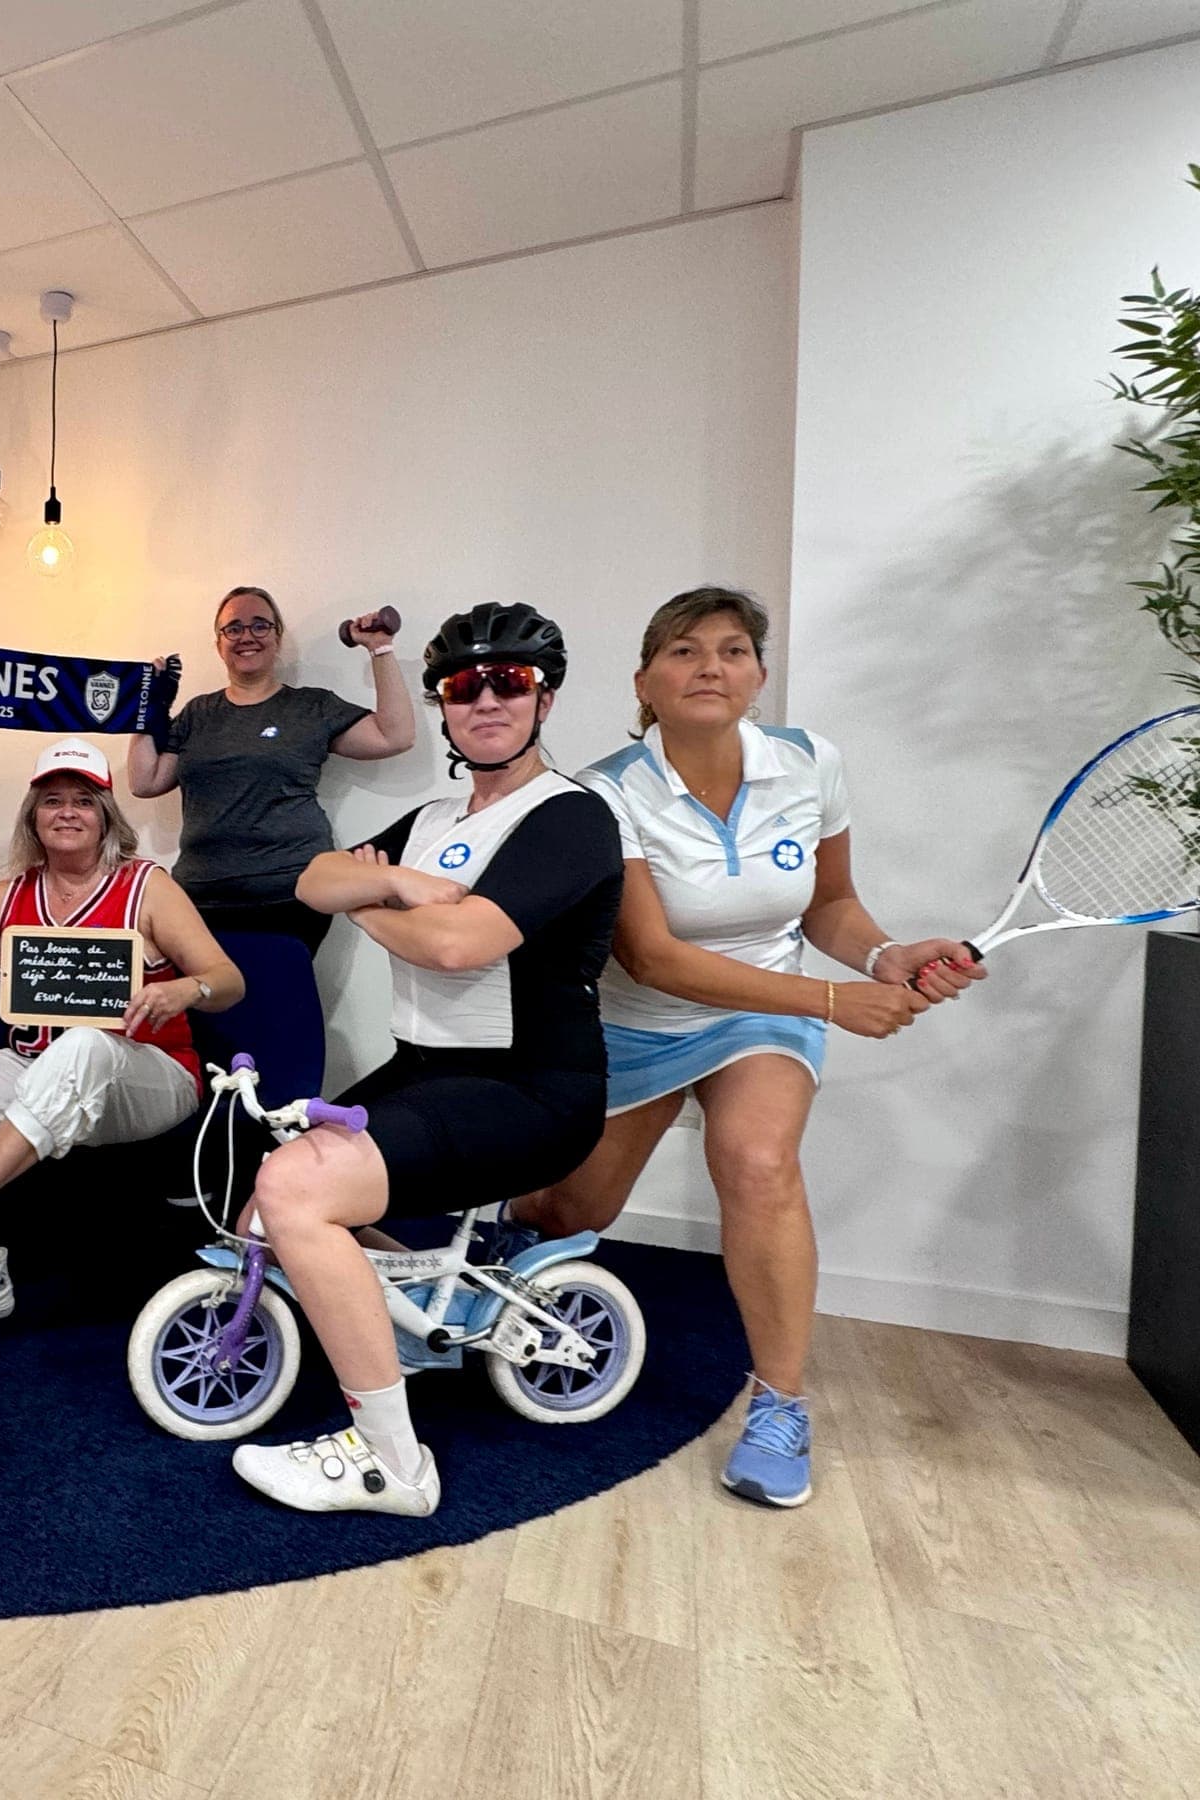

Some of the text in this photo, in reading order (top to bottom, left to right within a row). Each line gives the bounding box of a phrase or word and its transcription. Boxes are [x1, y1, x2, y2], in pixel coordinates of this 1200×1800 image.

[135, 664, 154, 730] BRETONNE
[19, 940, 107, 954] Pas besoin de
[106, 959, 126, 969] est
[20, 968, 47, 987] déjà
